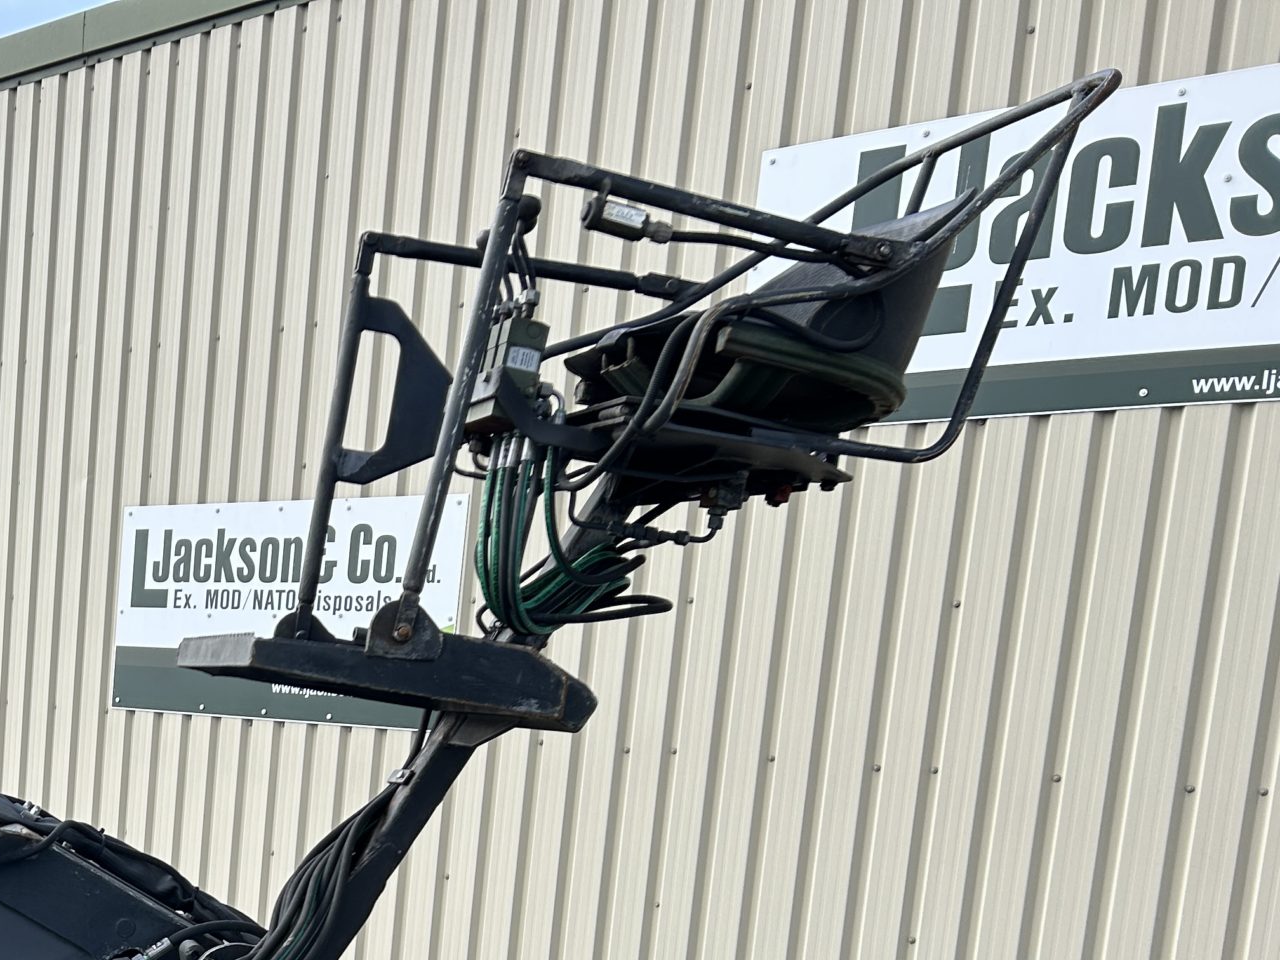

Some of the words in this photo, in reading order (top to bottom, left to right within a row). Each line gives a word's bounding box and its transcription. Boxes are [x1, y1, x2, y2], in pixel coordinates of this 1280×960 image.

[993, 278, 1074, 329] Ex.
[1192, 369, 1280, 394] www.lj
[347, 523, 402, 584] Co.
[173, 588, 197, 609] Ex.
[205, 588, 296, 611] MOD/NATO
[316, 590, 392, 615] isposals
